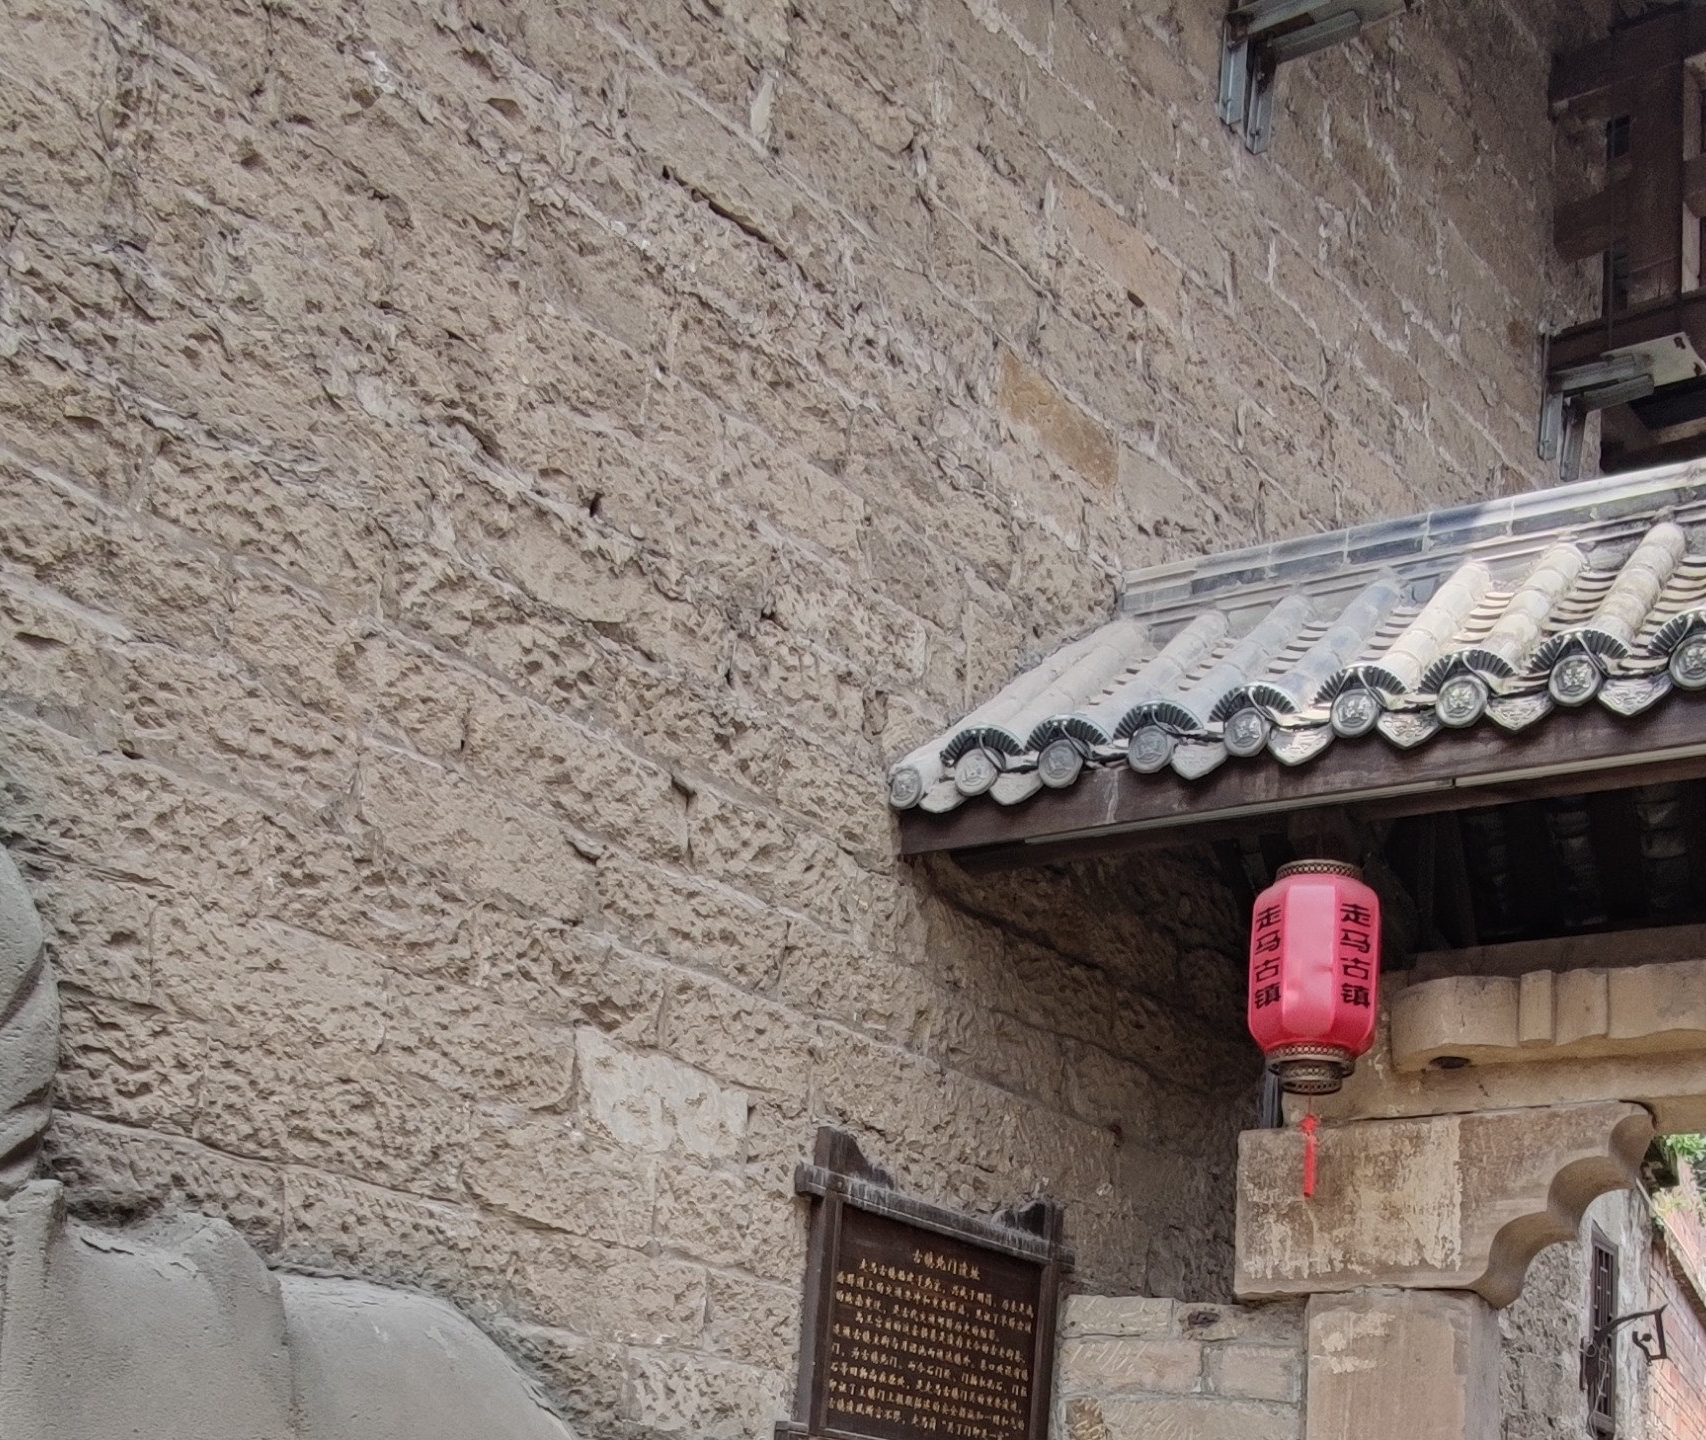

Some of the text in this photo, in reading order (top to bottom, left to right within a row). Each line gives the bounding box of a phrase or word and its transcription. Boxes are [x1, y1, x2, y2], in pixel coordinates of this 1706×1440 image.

[1254, 903, 1281, 1010] 走马古镇
[1340, 902, 1371, 1010] 走马古镇
